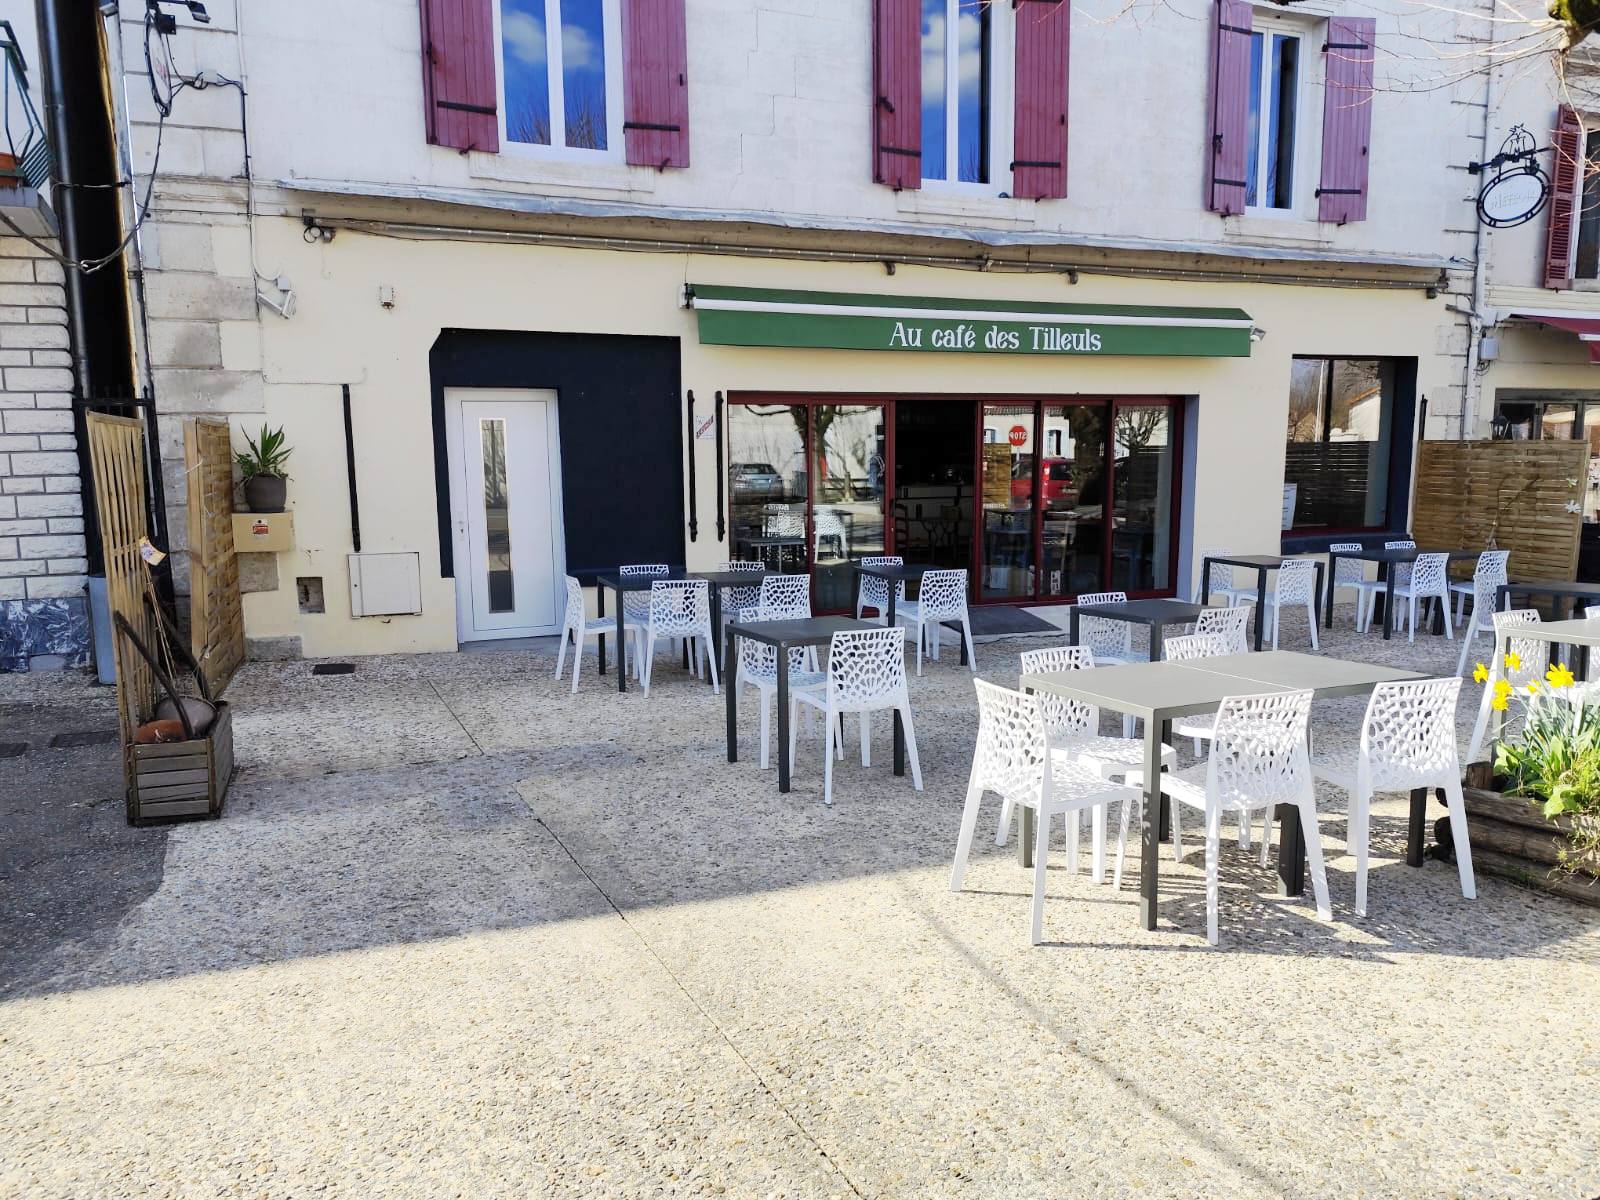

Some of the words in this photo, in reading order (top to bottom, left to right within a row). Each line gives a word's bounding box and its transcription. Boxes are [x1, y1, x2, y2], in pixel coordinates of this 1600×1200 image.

[889, 322, 922, 347] Au
[931, 324, 976, 348] café
[984, 325, 1020, 350] des
[1028, 326, 1102, 351] Tilleuls
